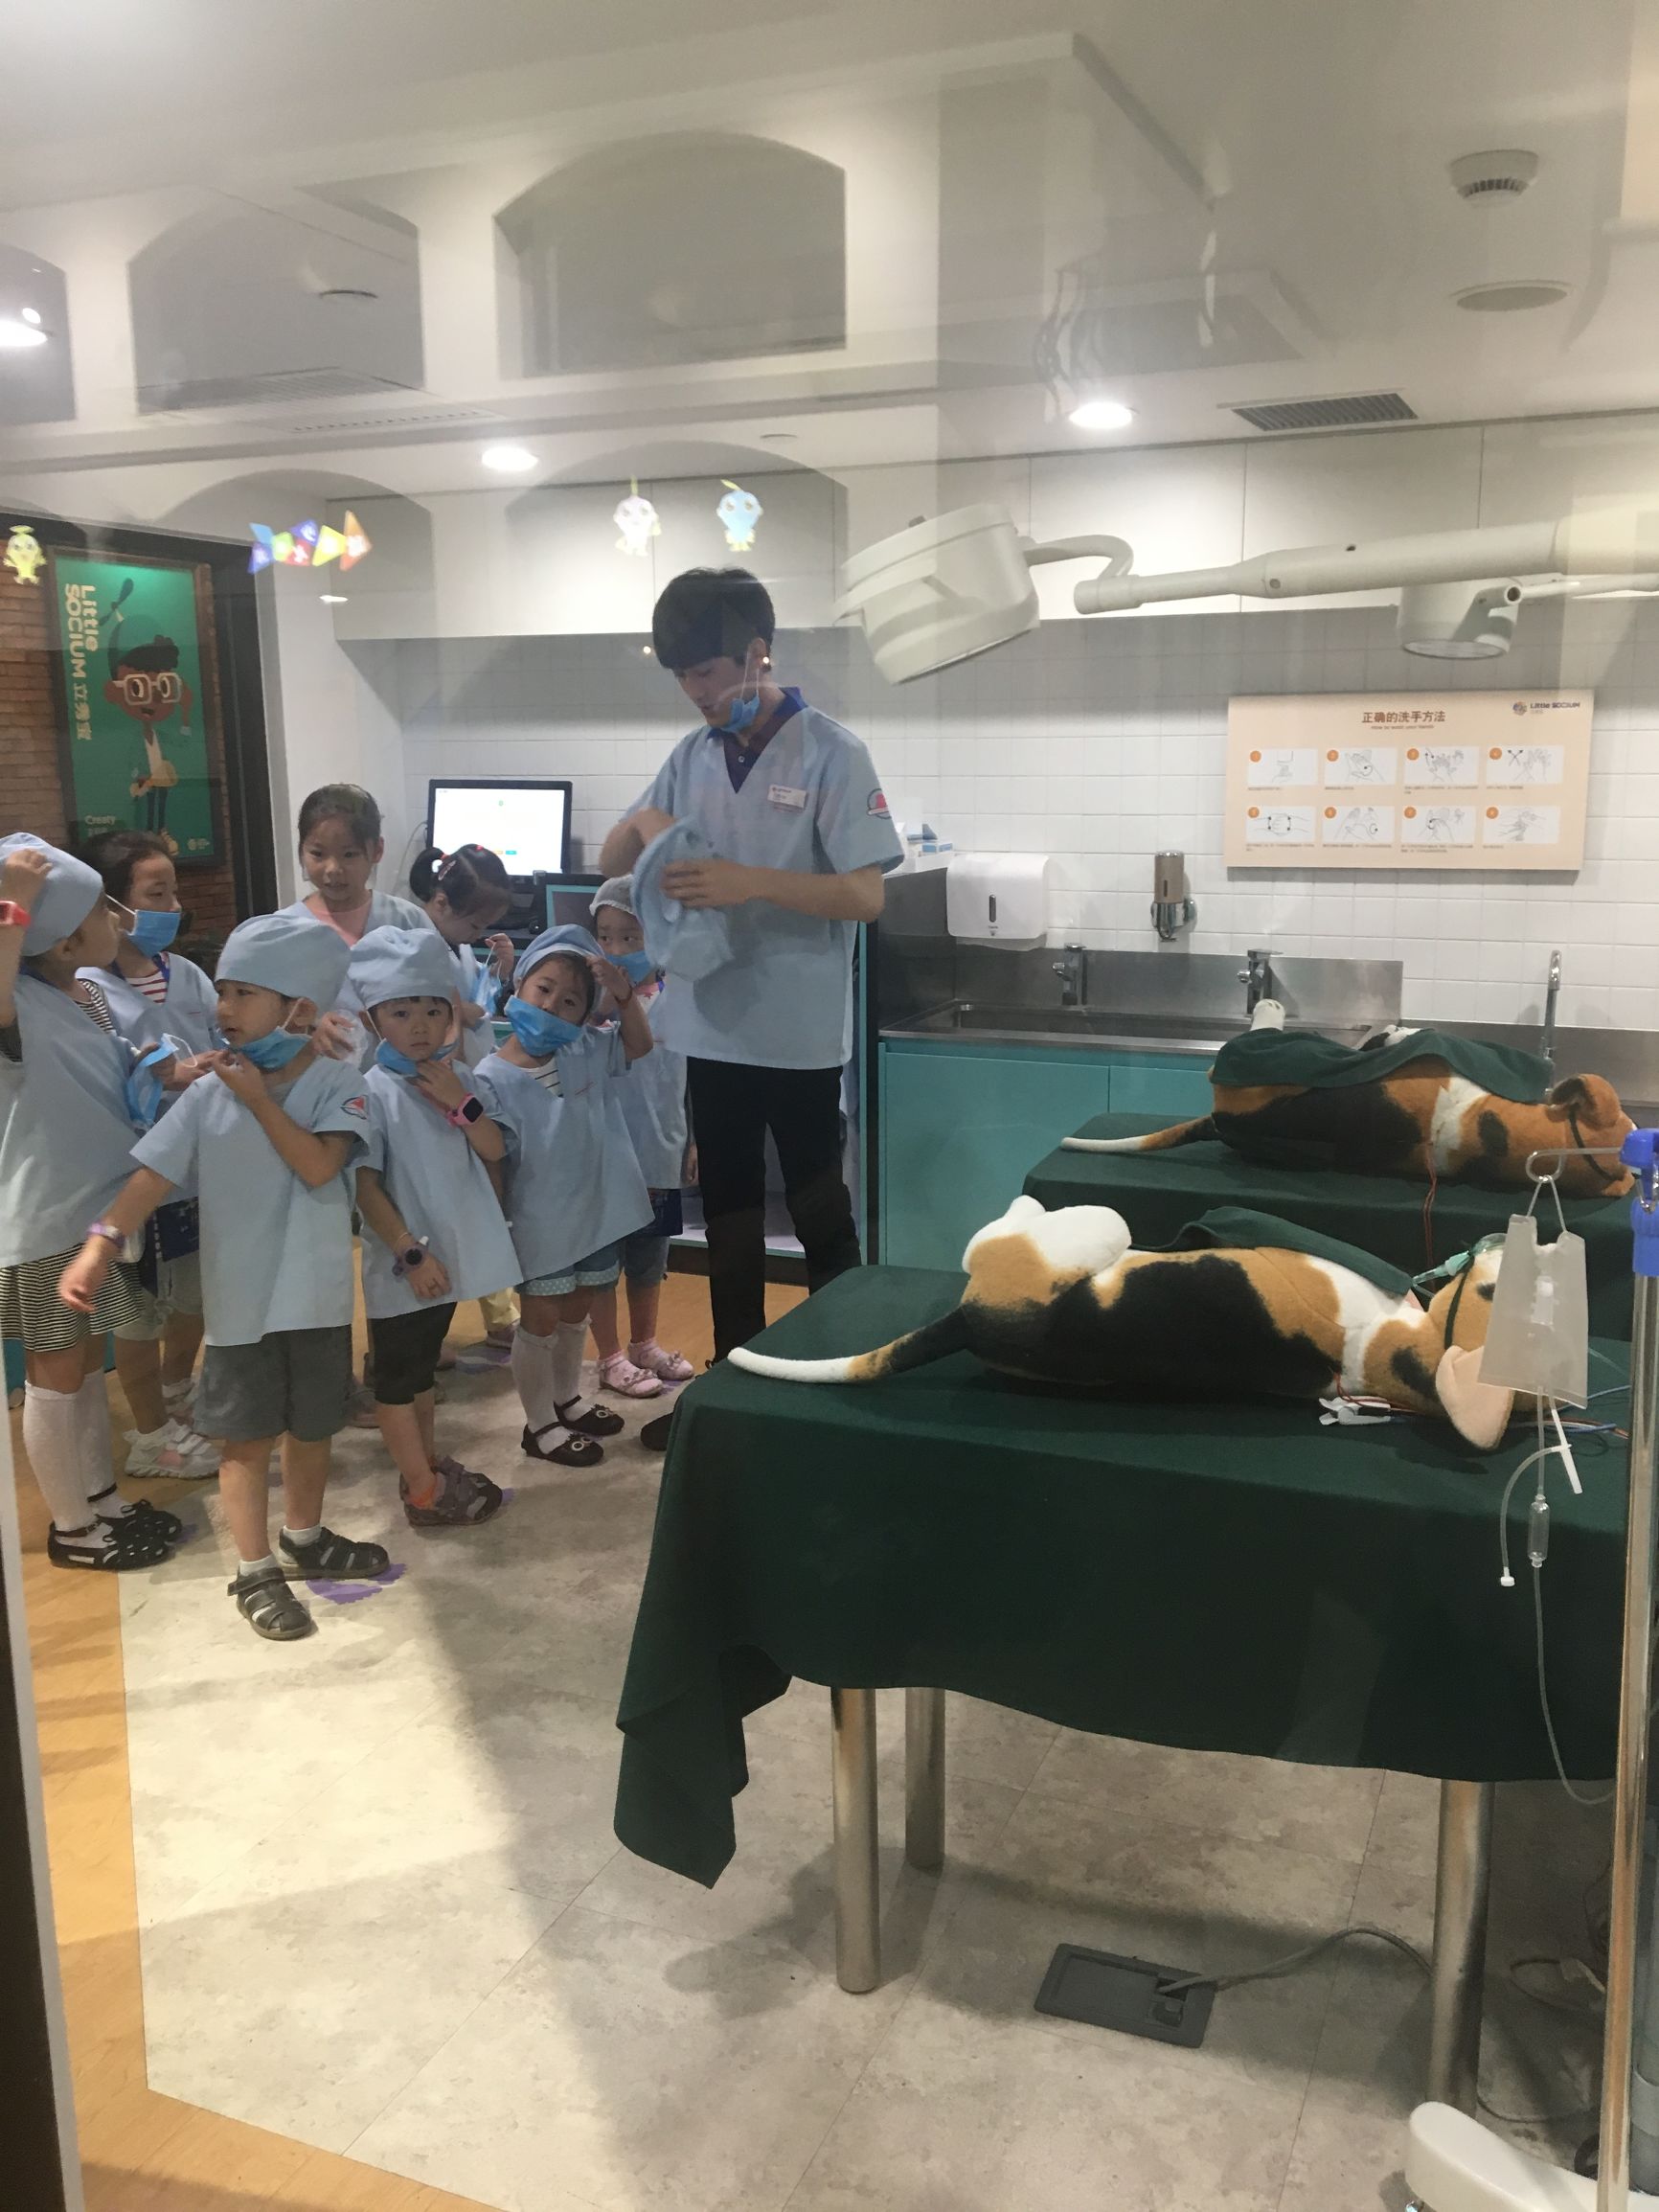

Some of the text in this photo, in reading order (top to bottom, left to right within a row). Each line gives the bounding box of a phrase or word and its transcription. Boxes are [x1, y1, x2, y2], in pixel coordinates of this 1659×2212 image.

[65, 582, 86, 678] SOCIUM
[80, 584, 99, 651] Little
[1362, 710, 1446, 723] 正确的洗手方法
